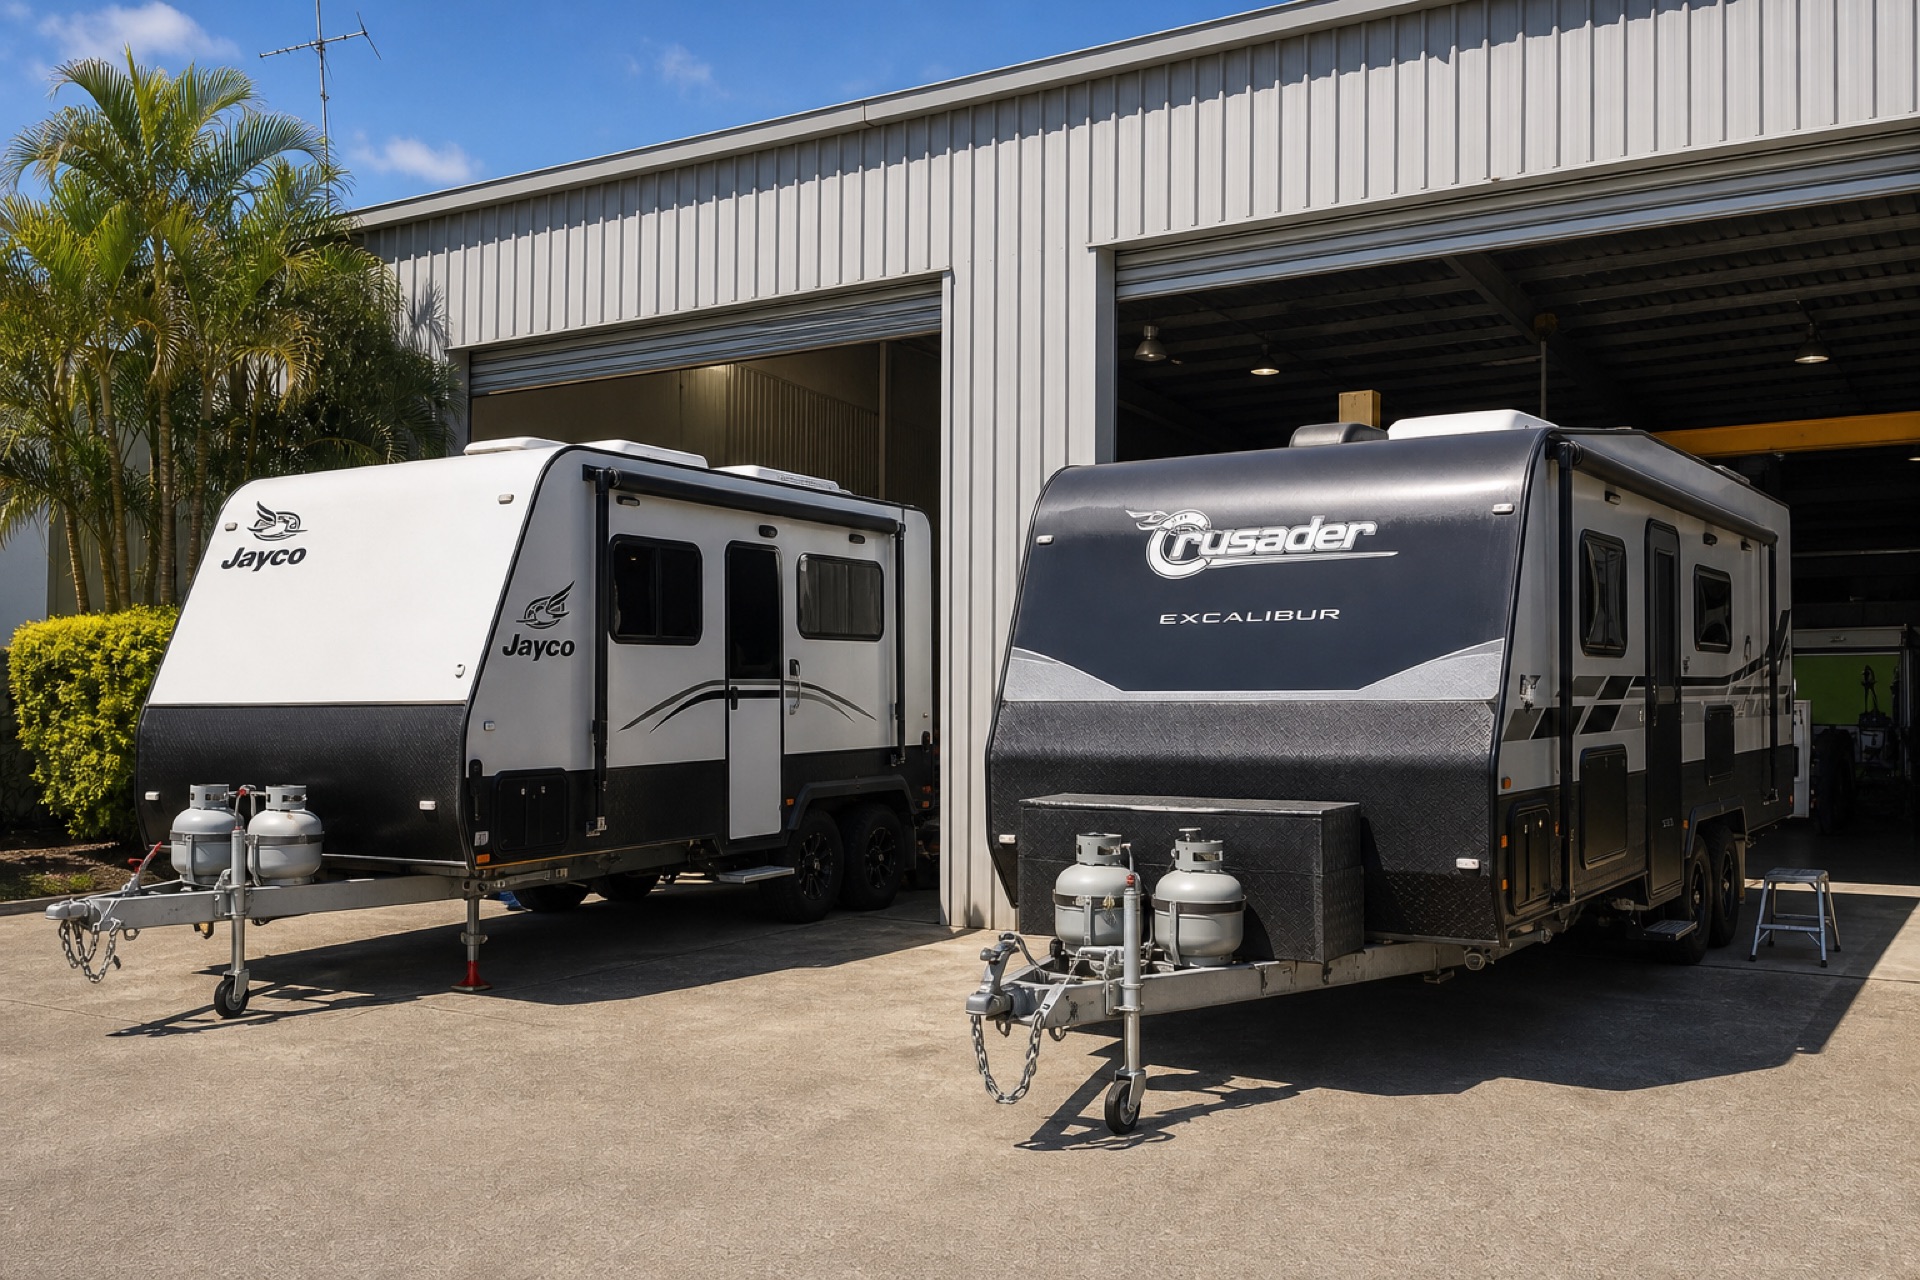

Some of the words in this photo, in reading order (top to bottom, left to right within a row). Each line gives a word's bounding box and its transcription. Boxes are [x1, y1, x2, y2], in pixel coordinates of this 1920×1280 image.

[1146, 509, 1378, 580] Crusader
[221, 547, 307, 572] Jayco
[1159, 609, 1340, 625] EXCALIBUR
[502, 633, 576, 662] Jayco
